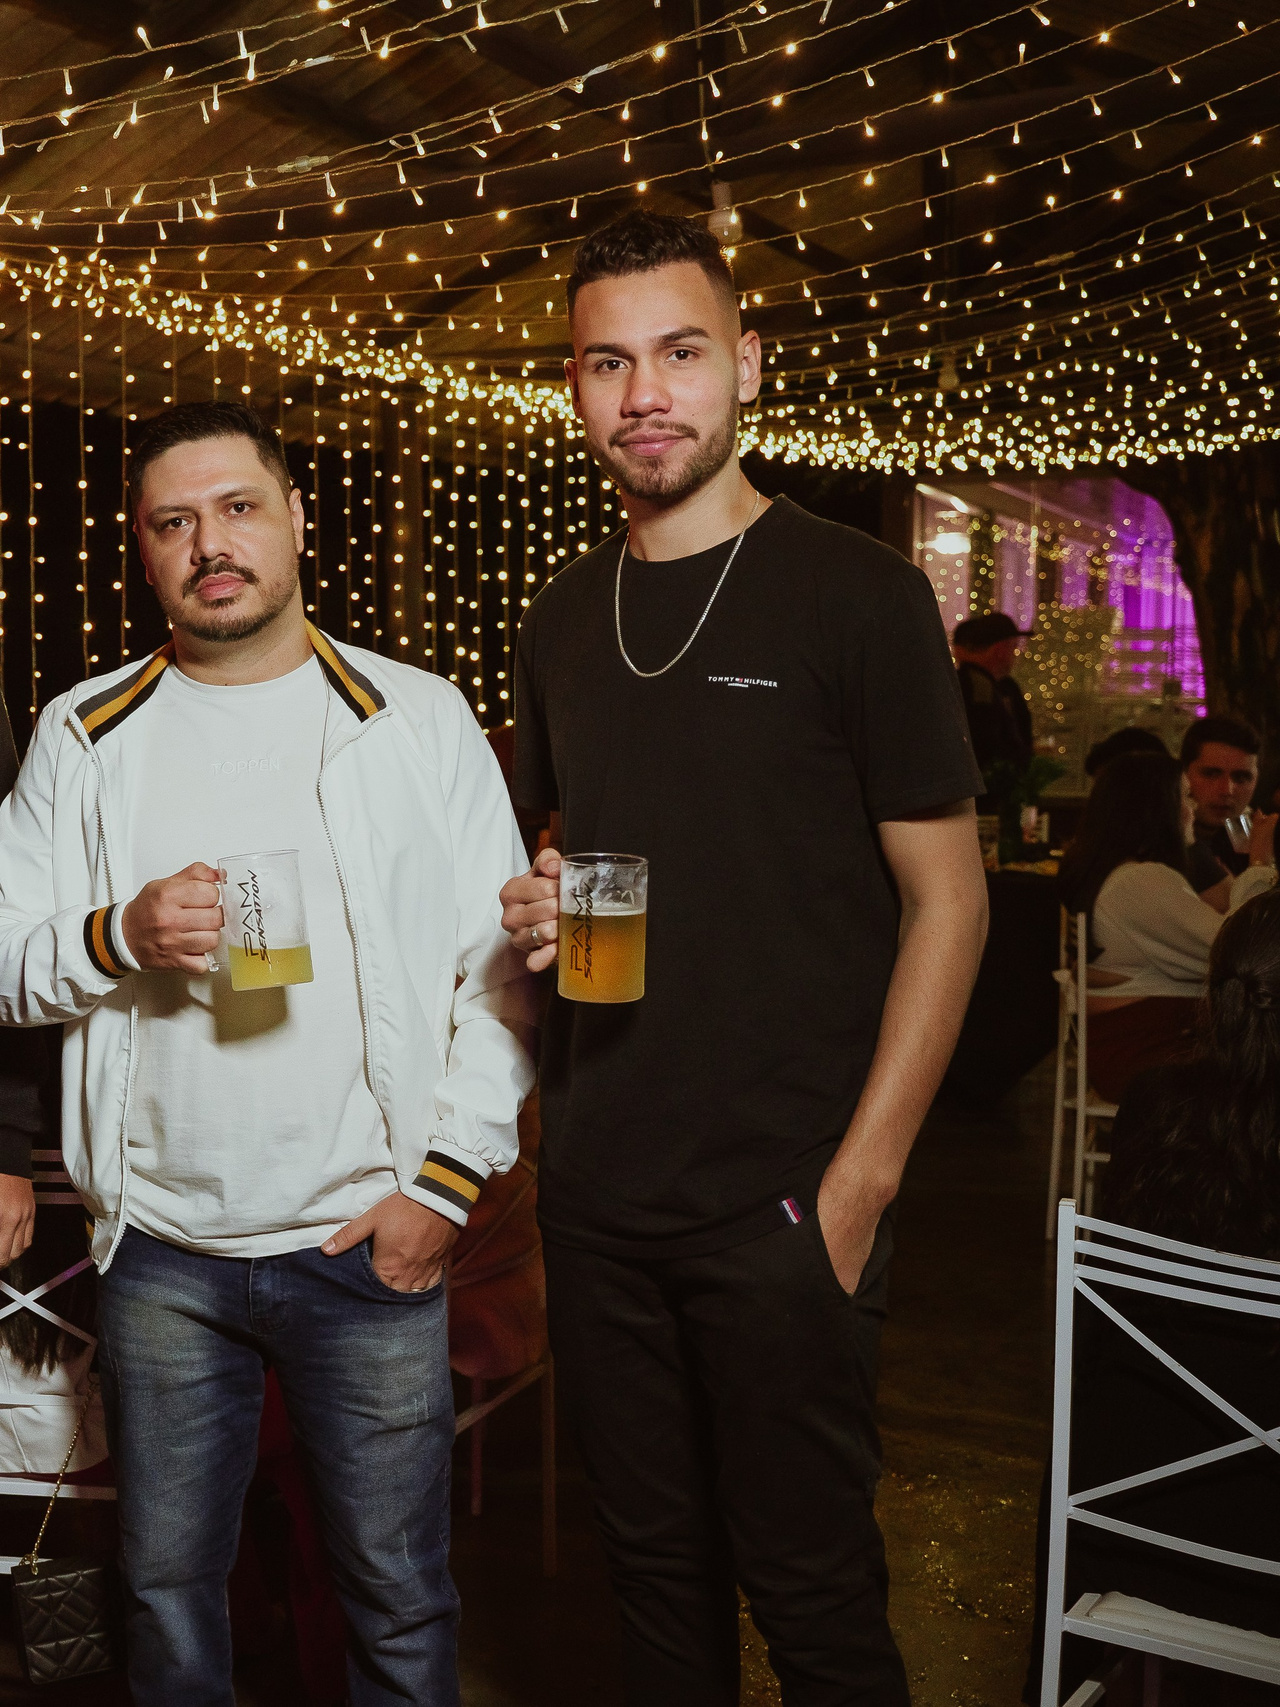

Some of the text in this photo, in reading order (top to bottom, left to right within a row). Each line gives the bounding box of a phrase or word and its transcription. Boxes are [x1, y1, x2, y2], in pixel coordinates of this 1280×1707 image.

[744, 678, 778, 688] HILFIGER
[211, 757, 280, 775] TOPPEN
[237, 882, 259, 957] PAM
[247, 869, 271, 964] SENSATION
[570, 893, 584, 971] PAM
[583, 882, 595, 983] SENSATION
